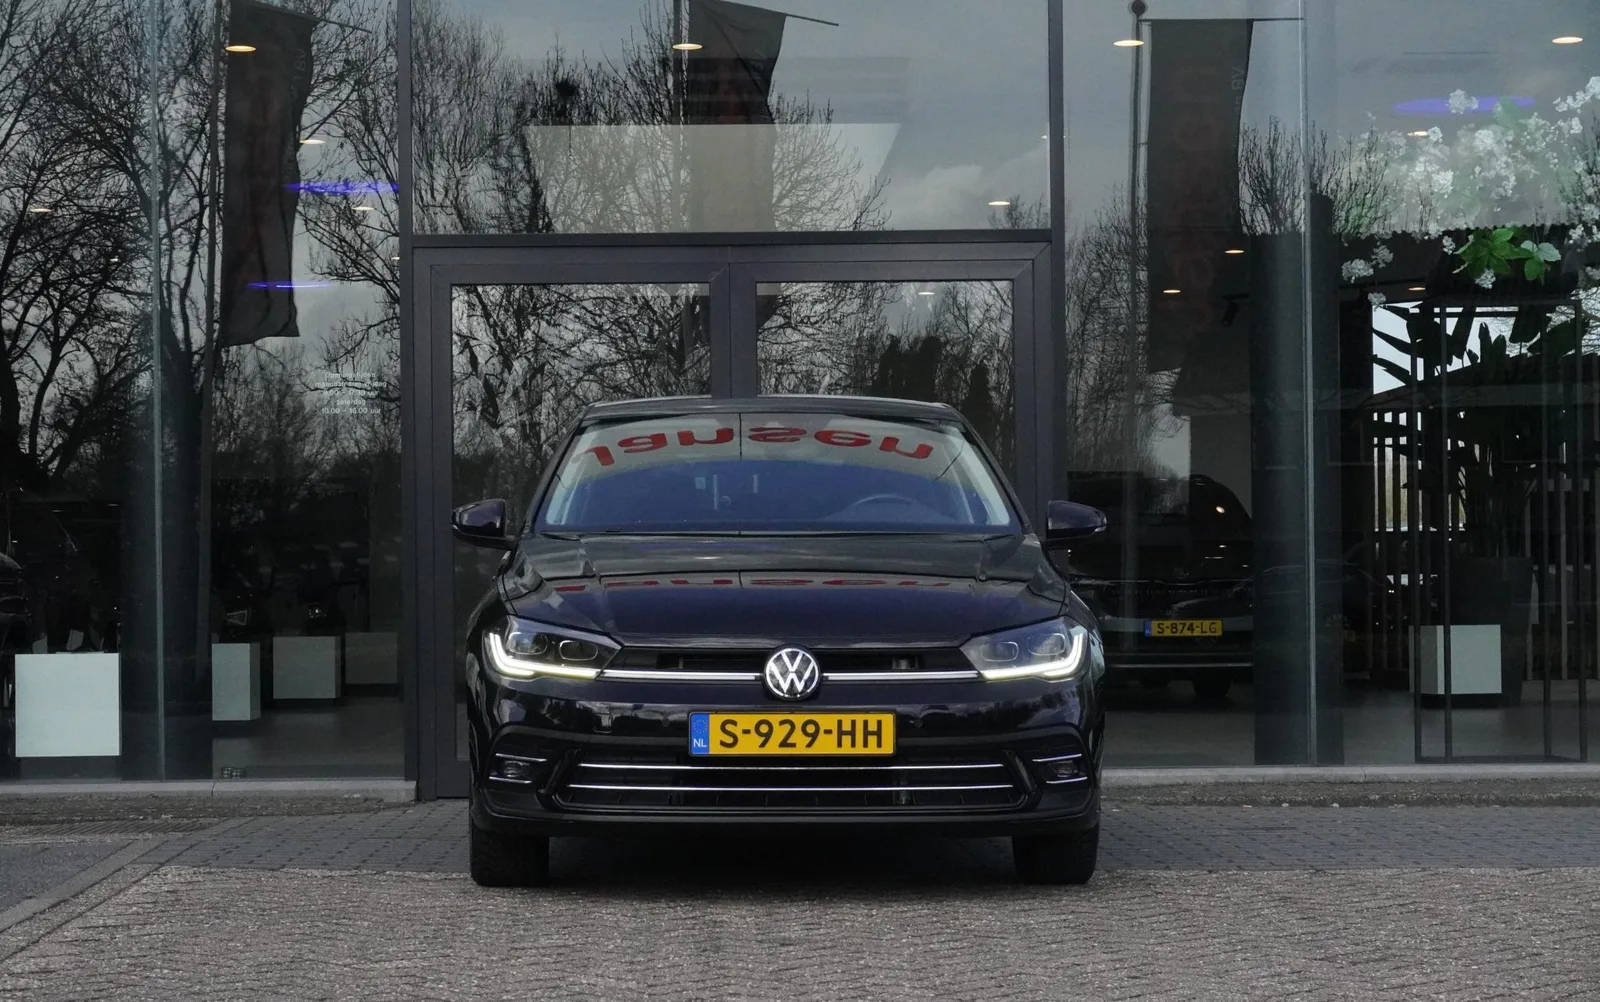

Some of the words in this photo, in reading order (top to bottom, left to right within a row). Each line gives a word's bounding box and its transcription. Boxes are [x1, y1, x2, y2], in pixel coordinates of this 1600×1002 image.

[1157, 622, 1217, 634] S-874-LG
[719, 719, 883, 748] S-929-HH
[693, 739, 707, 748] NL
